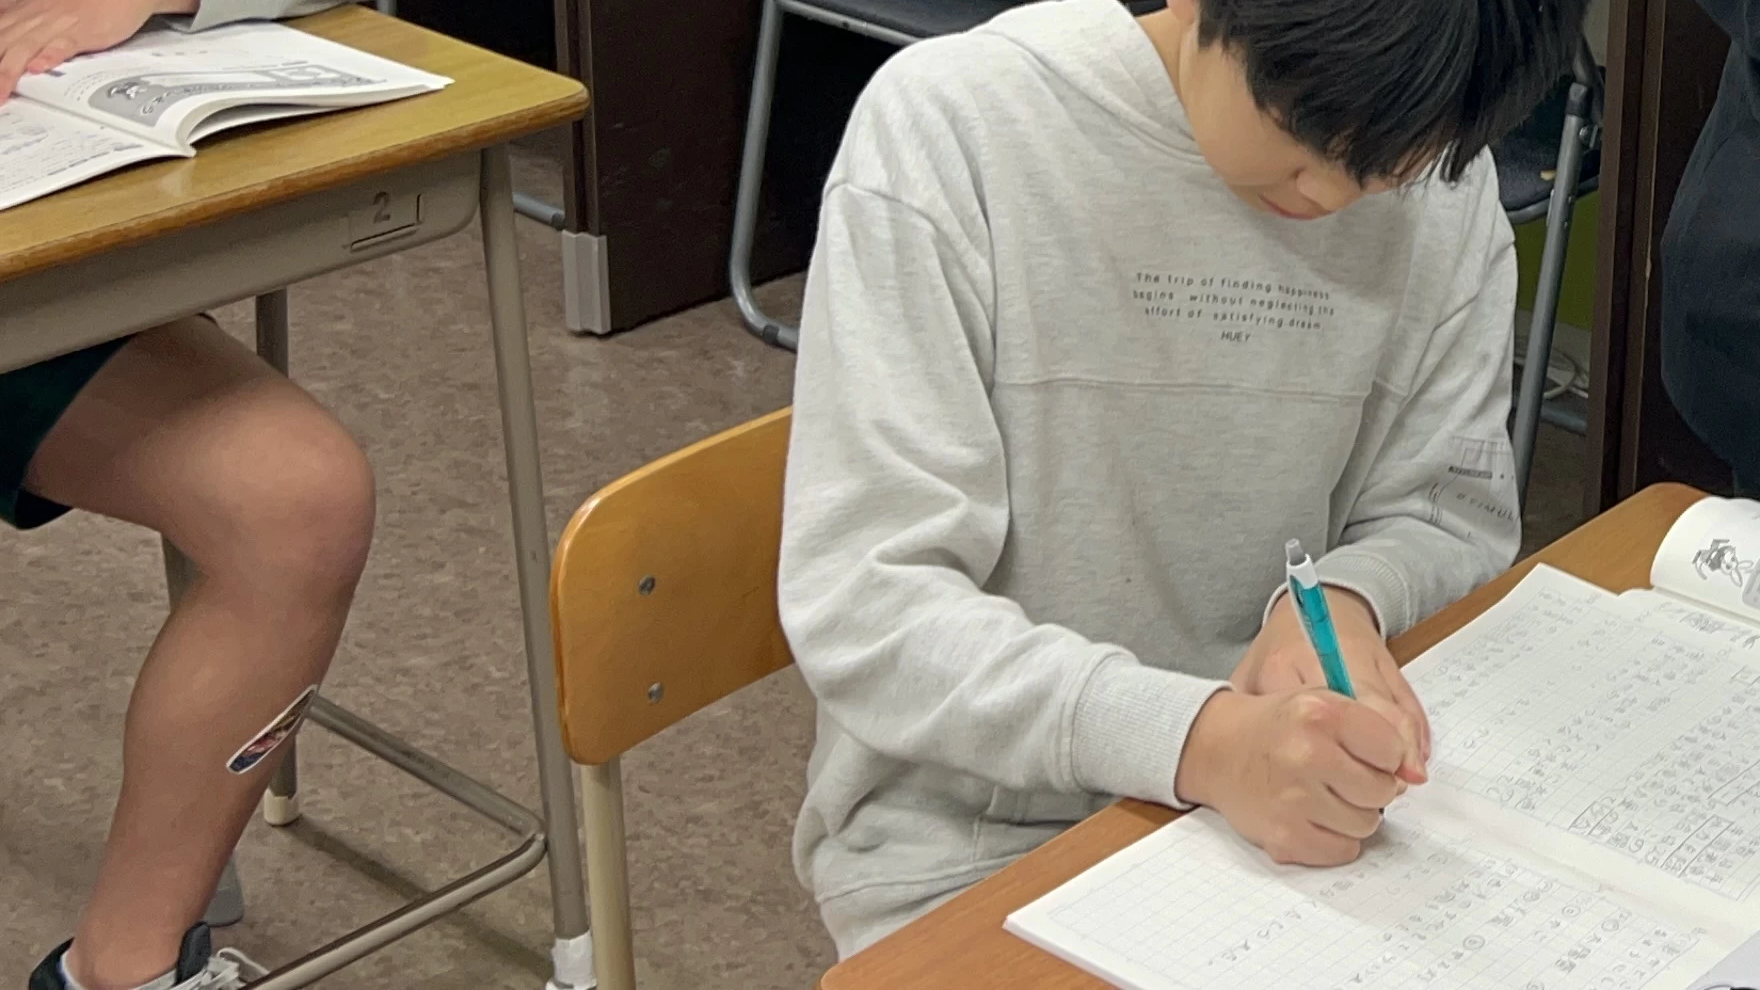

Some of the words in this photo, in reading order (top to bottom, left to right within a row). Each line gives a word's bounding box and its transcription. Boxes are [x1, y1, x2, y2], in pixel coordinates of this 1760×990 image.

[372, 191, 392, 224] 2
[1136, 272, 1160, 284] The
[1167, 275, 1195, 287] trip
[1200, 277, 1215, 287] of
[1220, 277, 1273, 294] finding
[1189, 293, 1244, 306] without
[1249, 297, 1315, 316] neglecting
[1187, 308, 1203, 319] of
[1212, 311, 1284, 329] satisfying
